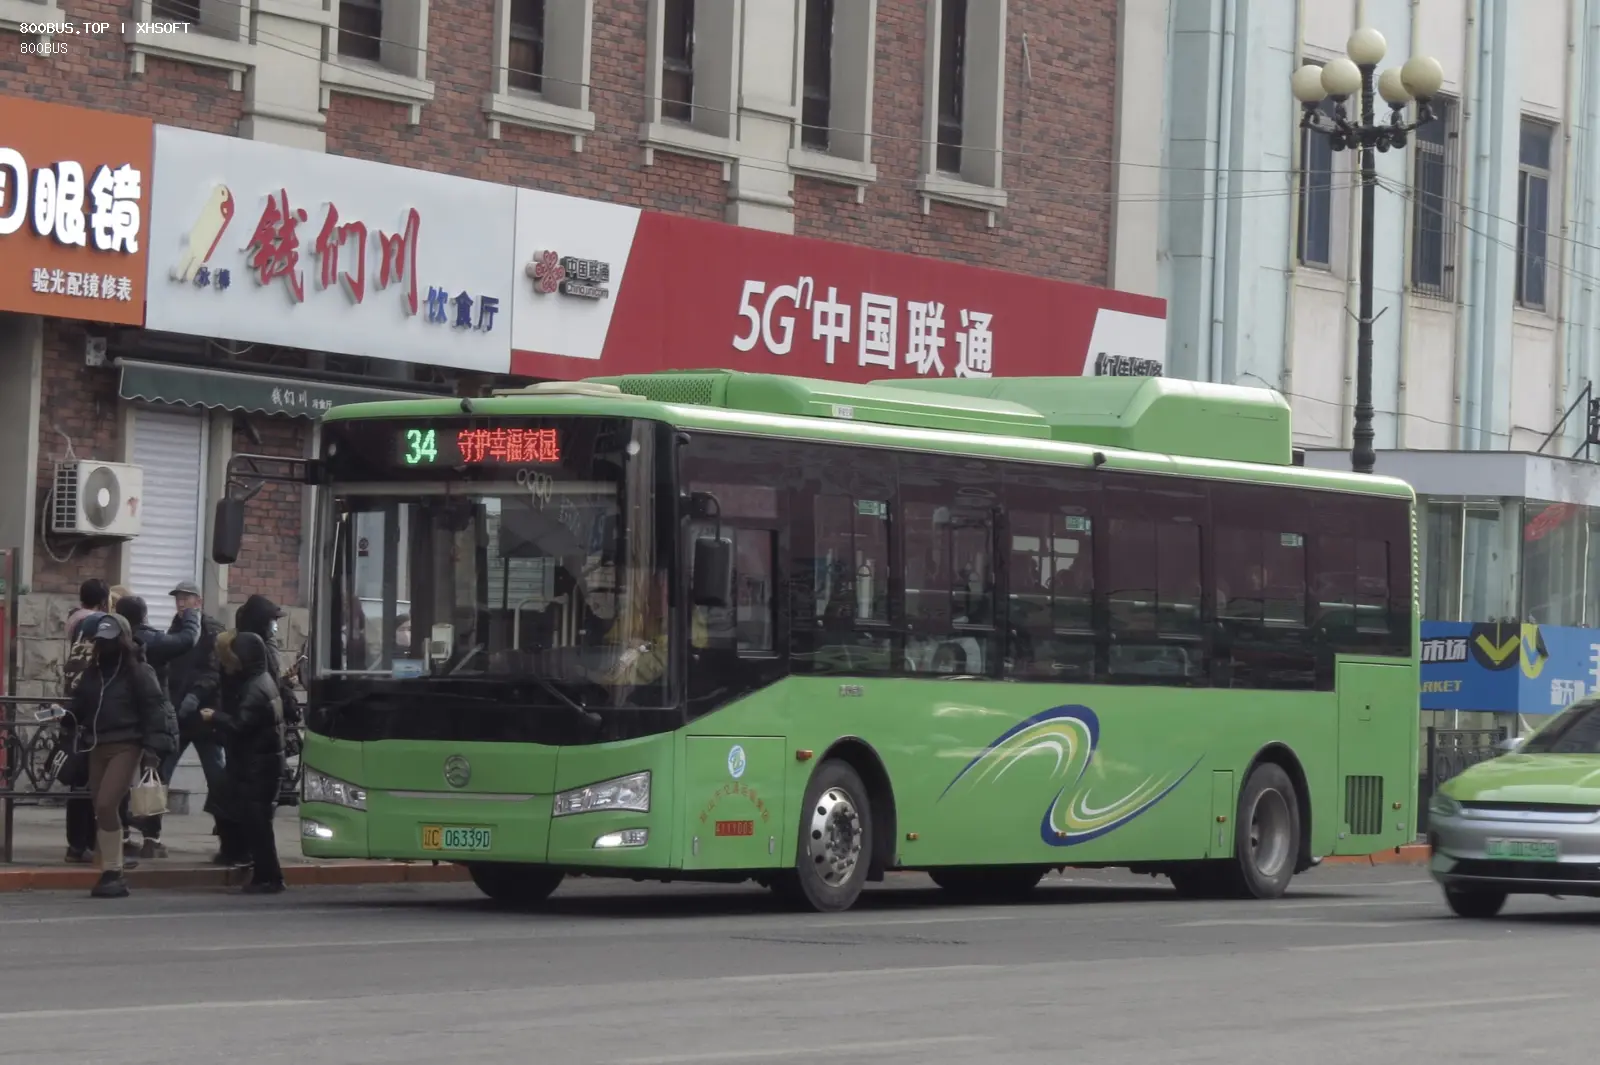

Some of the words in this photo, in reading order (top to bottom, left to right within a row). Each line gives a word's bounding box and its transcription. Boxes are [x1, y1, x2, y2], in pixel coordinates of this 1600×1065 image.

[33, 267, 133, 301] 验光配镜修表
[427, 285, 499, 332] 饮食厅
[405, 429, 438, 464] 34
[457, 428, 561, 463] 守护幸福家园
[1420, 638, 1468, 662] 市场
[445, 829, 490, 847] 06339D
